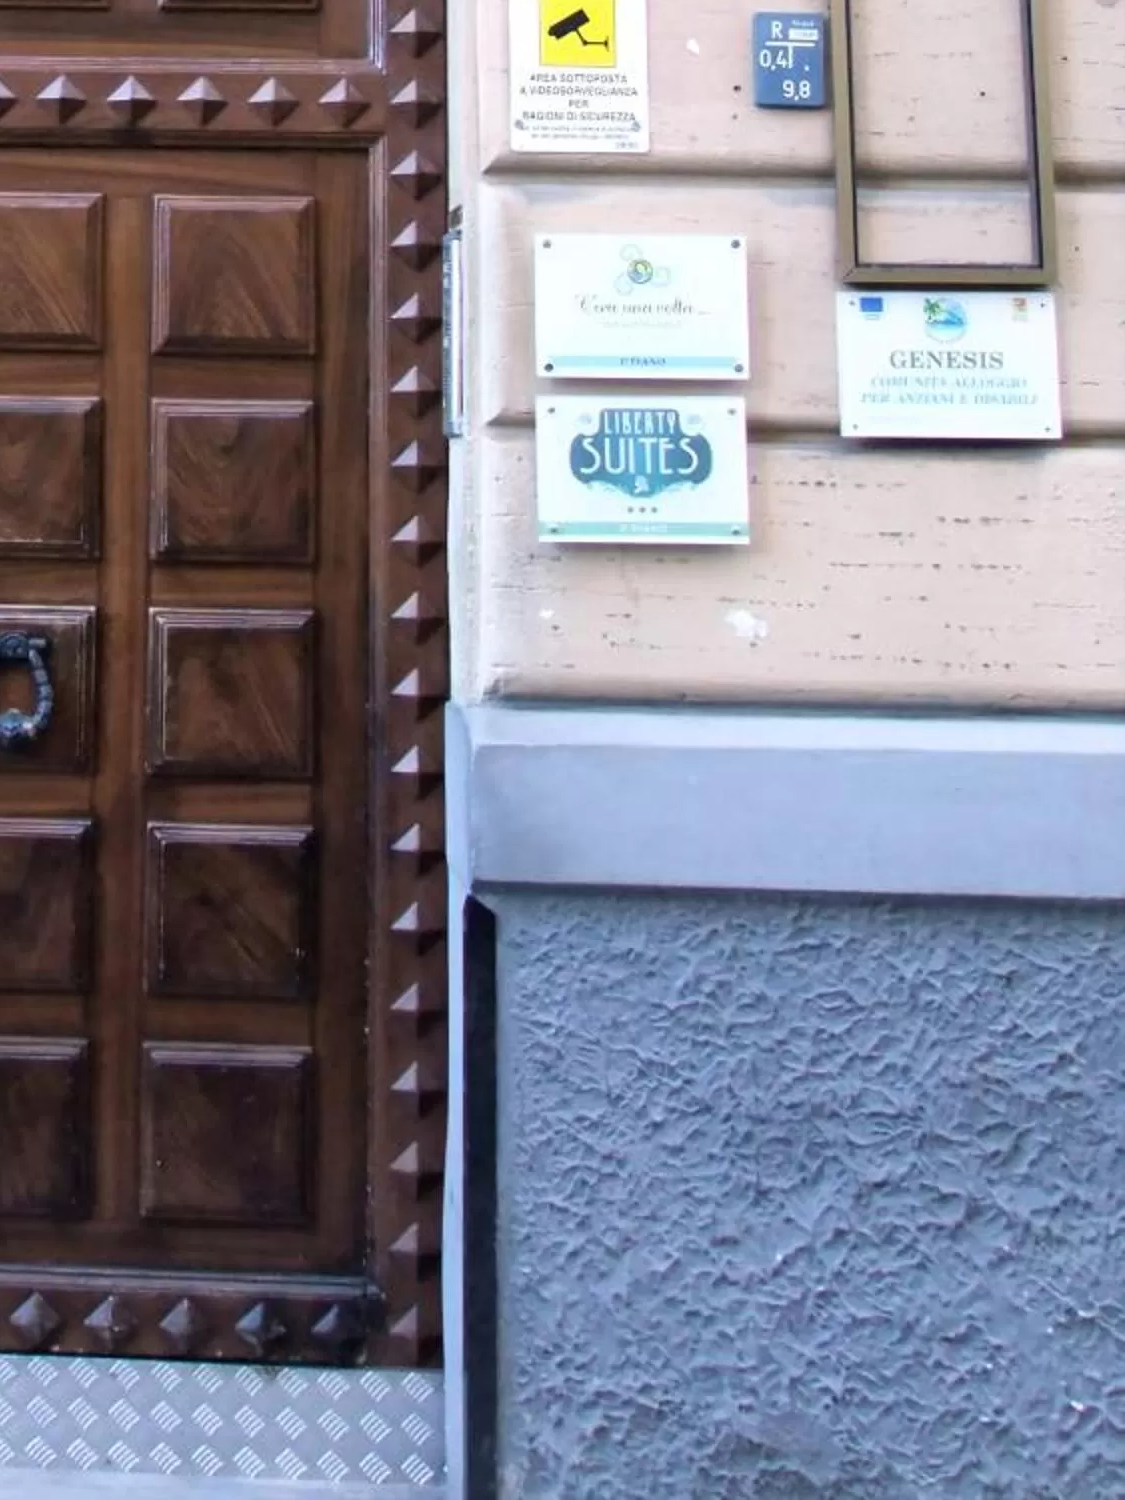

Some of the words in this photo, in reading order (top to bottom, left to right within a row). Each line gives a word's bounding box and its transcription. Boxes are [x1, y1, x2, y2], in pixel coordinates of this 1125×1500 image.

[770, 20, 783, 39] R
[758, 49, 787, 71] 0,4
[530, 73, 557, 83] AREA
[559, 73, 628, 84] SOTTOPOSTA
[782, 79, 811, 101] 9,8
[568, 99, 589, 109] PER
[889, 349, 1005, 370] GENESIS
[604, 411, 676, 435] LIBERTY
[579, 436, 700, 476] SUITES
